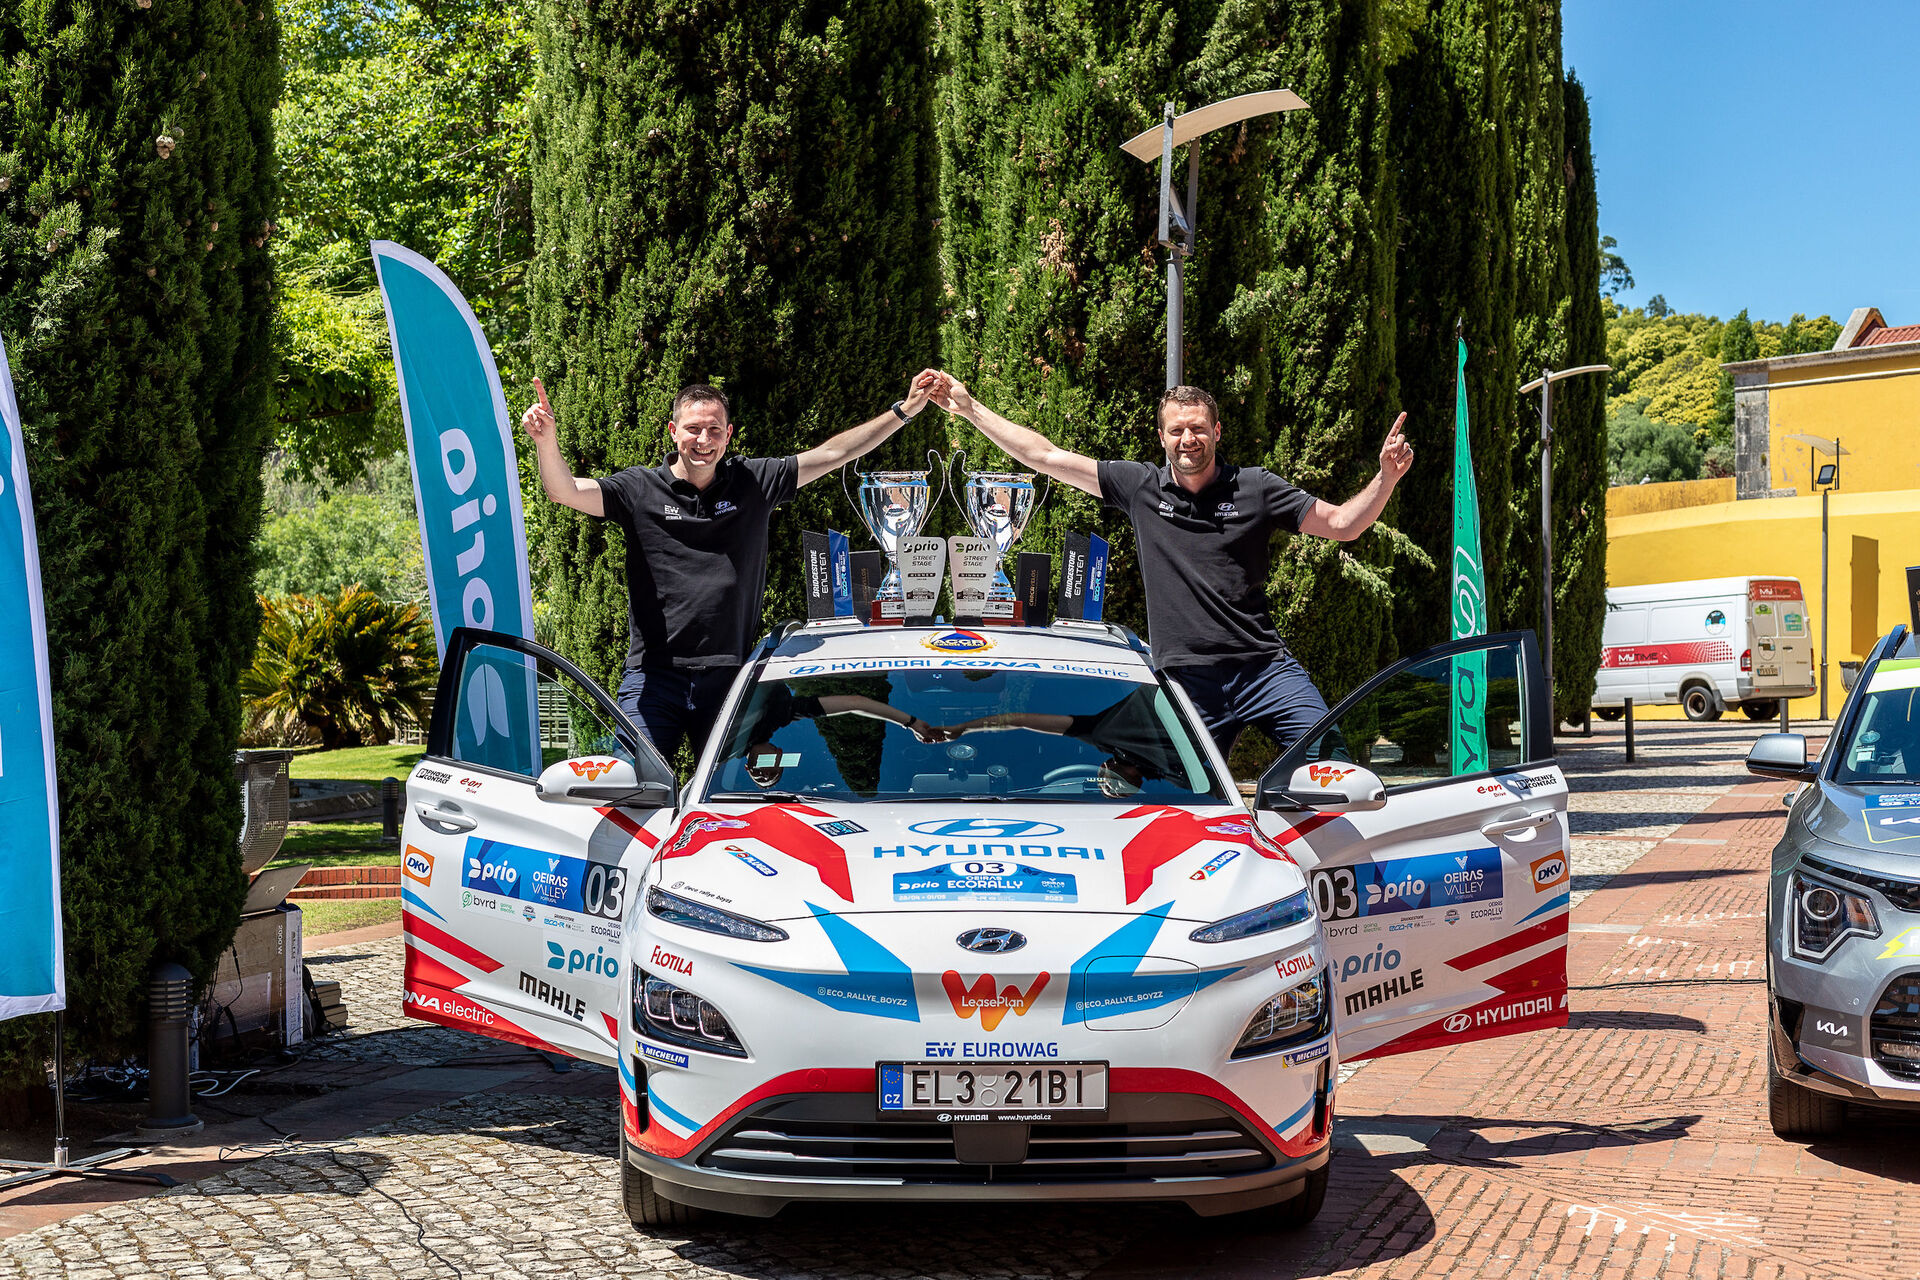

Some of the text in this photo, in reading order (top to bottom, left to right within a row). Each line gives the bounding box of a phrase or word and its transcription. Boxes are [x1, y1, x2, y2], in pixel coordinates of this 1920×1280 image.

[914, 541, 939, 553] prio
[966, 541, 990, 553] prio
[810, 549, 820, 598] BRIDGESTONE
[819, 552, 829, 594] ENLITEN
[1065, 550, 1076, 599] BRIDGESTONE
[1074, 554, 1085, 596] ENLITEN
[831, 659, 1131, 678] HYUNDAI KONA electric
[423, 775, 449, 784] CONTACT
[1528, 778, 1558, 789] CONTACT
[873, 844, 1105, 861] HYUNDAI
[407, 856, 430, 874] DKV
[481, 859, 517, 884] prio
[964, 862, 1005, 874] 03
[1537, 861, 1563, 881] DKV
[532, 870, 569, 888] OEIRAS
[911, 881, 940, 889] prio
[947, 880, 1023, 889] ECORALLY
[1443, 869, 1484, 884] OEIRAS
[532, 883, 567, 899] VALLEY
[585, 865, 627, 919] 03
[1312, 868, 1356, 918] 03
[1383, 874, 1426, 903] prio
[1443, 880, 1484, 896] VALLEY
[473, 894, 496, 910] byrd
[1470, 907, 1503, 920] ECORALLY
[591, 925, 622, 939] ECORALLY
[1329, 924, 1358, 938] byrd
[568, 946, 619, 979] prio
[650, 945, 694, 977] FLOTILA
[1275, 952, 1316, 979] FLOTILA
[1341, 942, 1401, 983] prio
[519, 970, 586, 1022] MAHLE
[826, 988, 908, 1007] ECO_RALLYE_BOYZZ
[1084, 991, 1164, 1009] ECO_RALLYE_BOYZZ
[1344, 968, 1424, 1017] MAHLE
[961, 996, 1024, 1008] LeasePlan
[443, 1000, 494, 1025] electric
[1476, 996, 1552, 1027] HYUNDAI
[645, 1046, 686, 1064] MICHELIN
[925, 1042, 1058, 1057] EW EUROWAG
[1295, 1043, 1328, 1062] MICHELIN
[911, 1070, 975, 1104] EL3
[884, 1093, 901, 1104] CZ
[998, 1113, 1052, 1122] www.hyundai.cz
